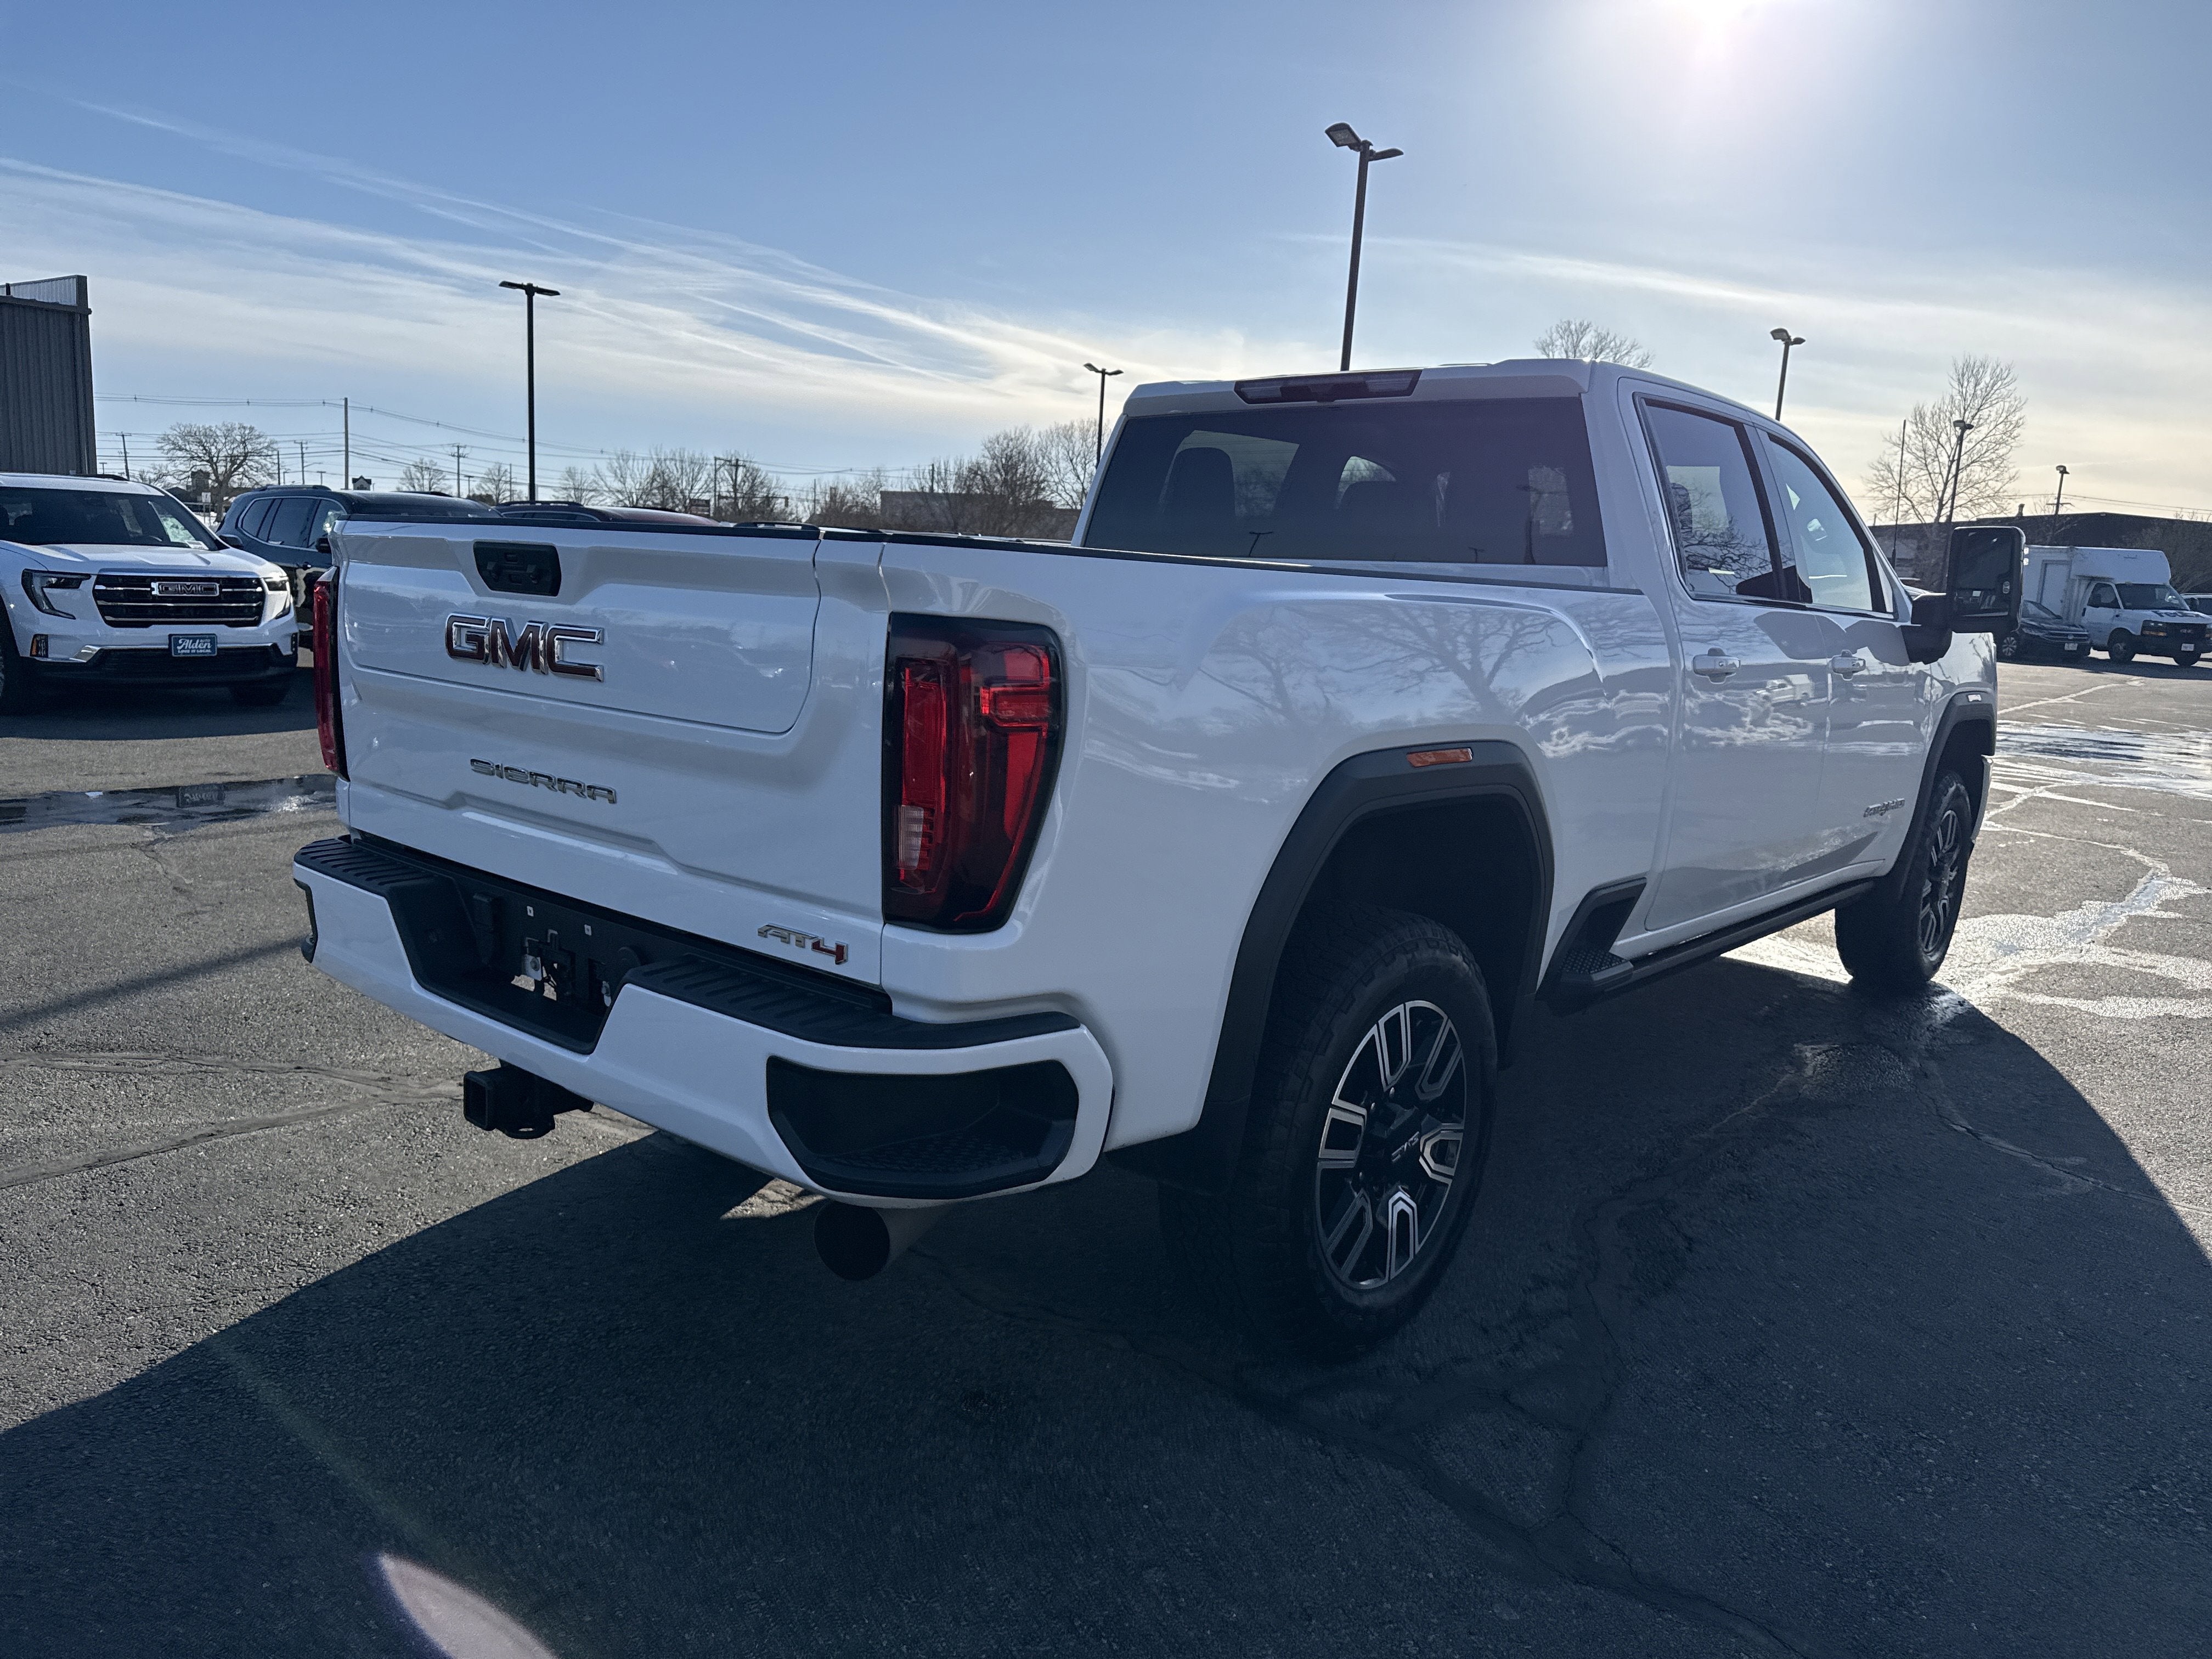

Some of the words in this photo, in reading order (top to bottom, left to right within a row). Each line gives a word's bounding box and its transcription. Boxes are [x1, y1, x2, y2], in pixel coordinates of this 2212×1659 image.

[159, 584, 217, 595] GMC
[177, 639, 212, 650] Alden
[445, 612, 604, 682] GMC
[470, 757, 617, 804] SIERRA
[758, 923, 848, 964] AT4
